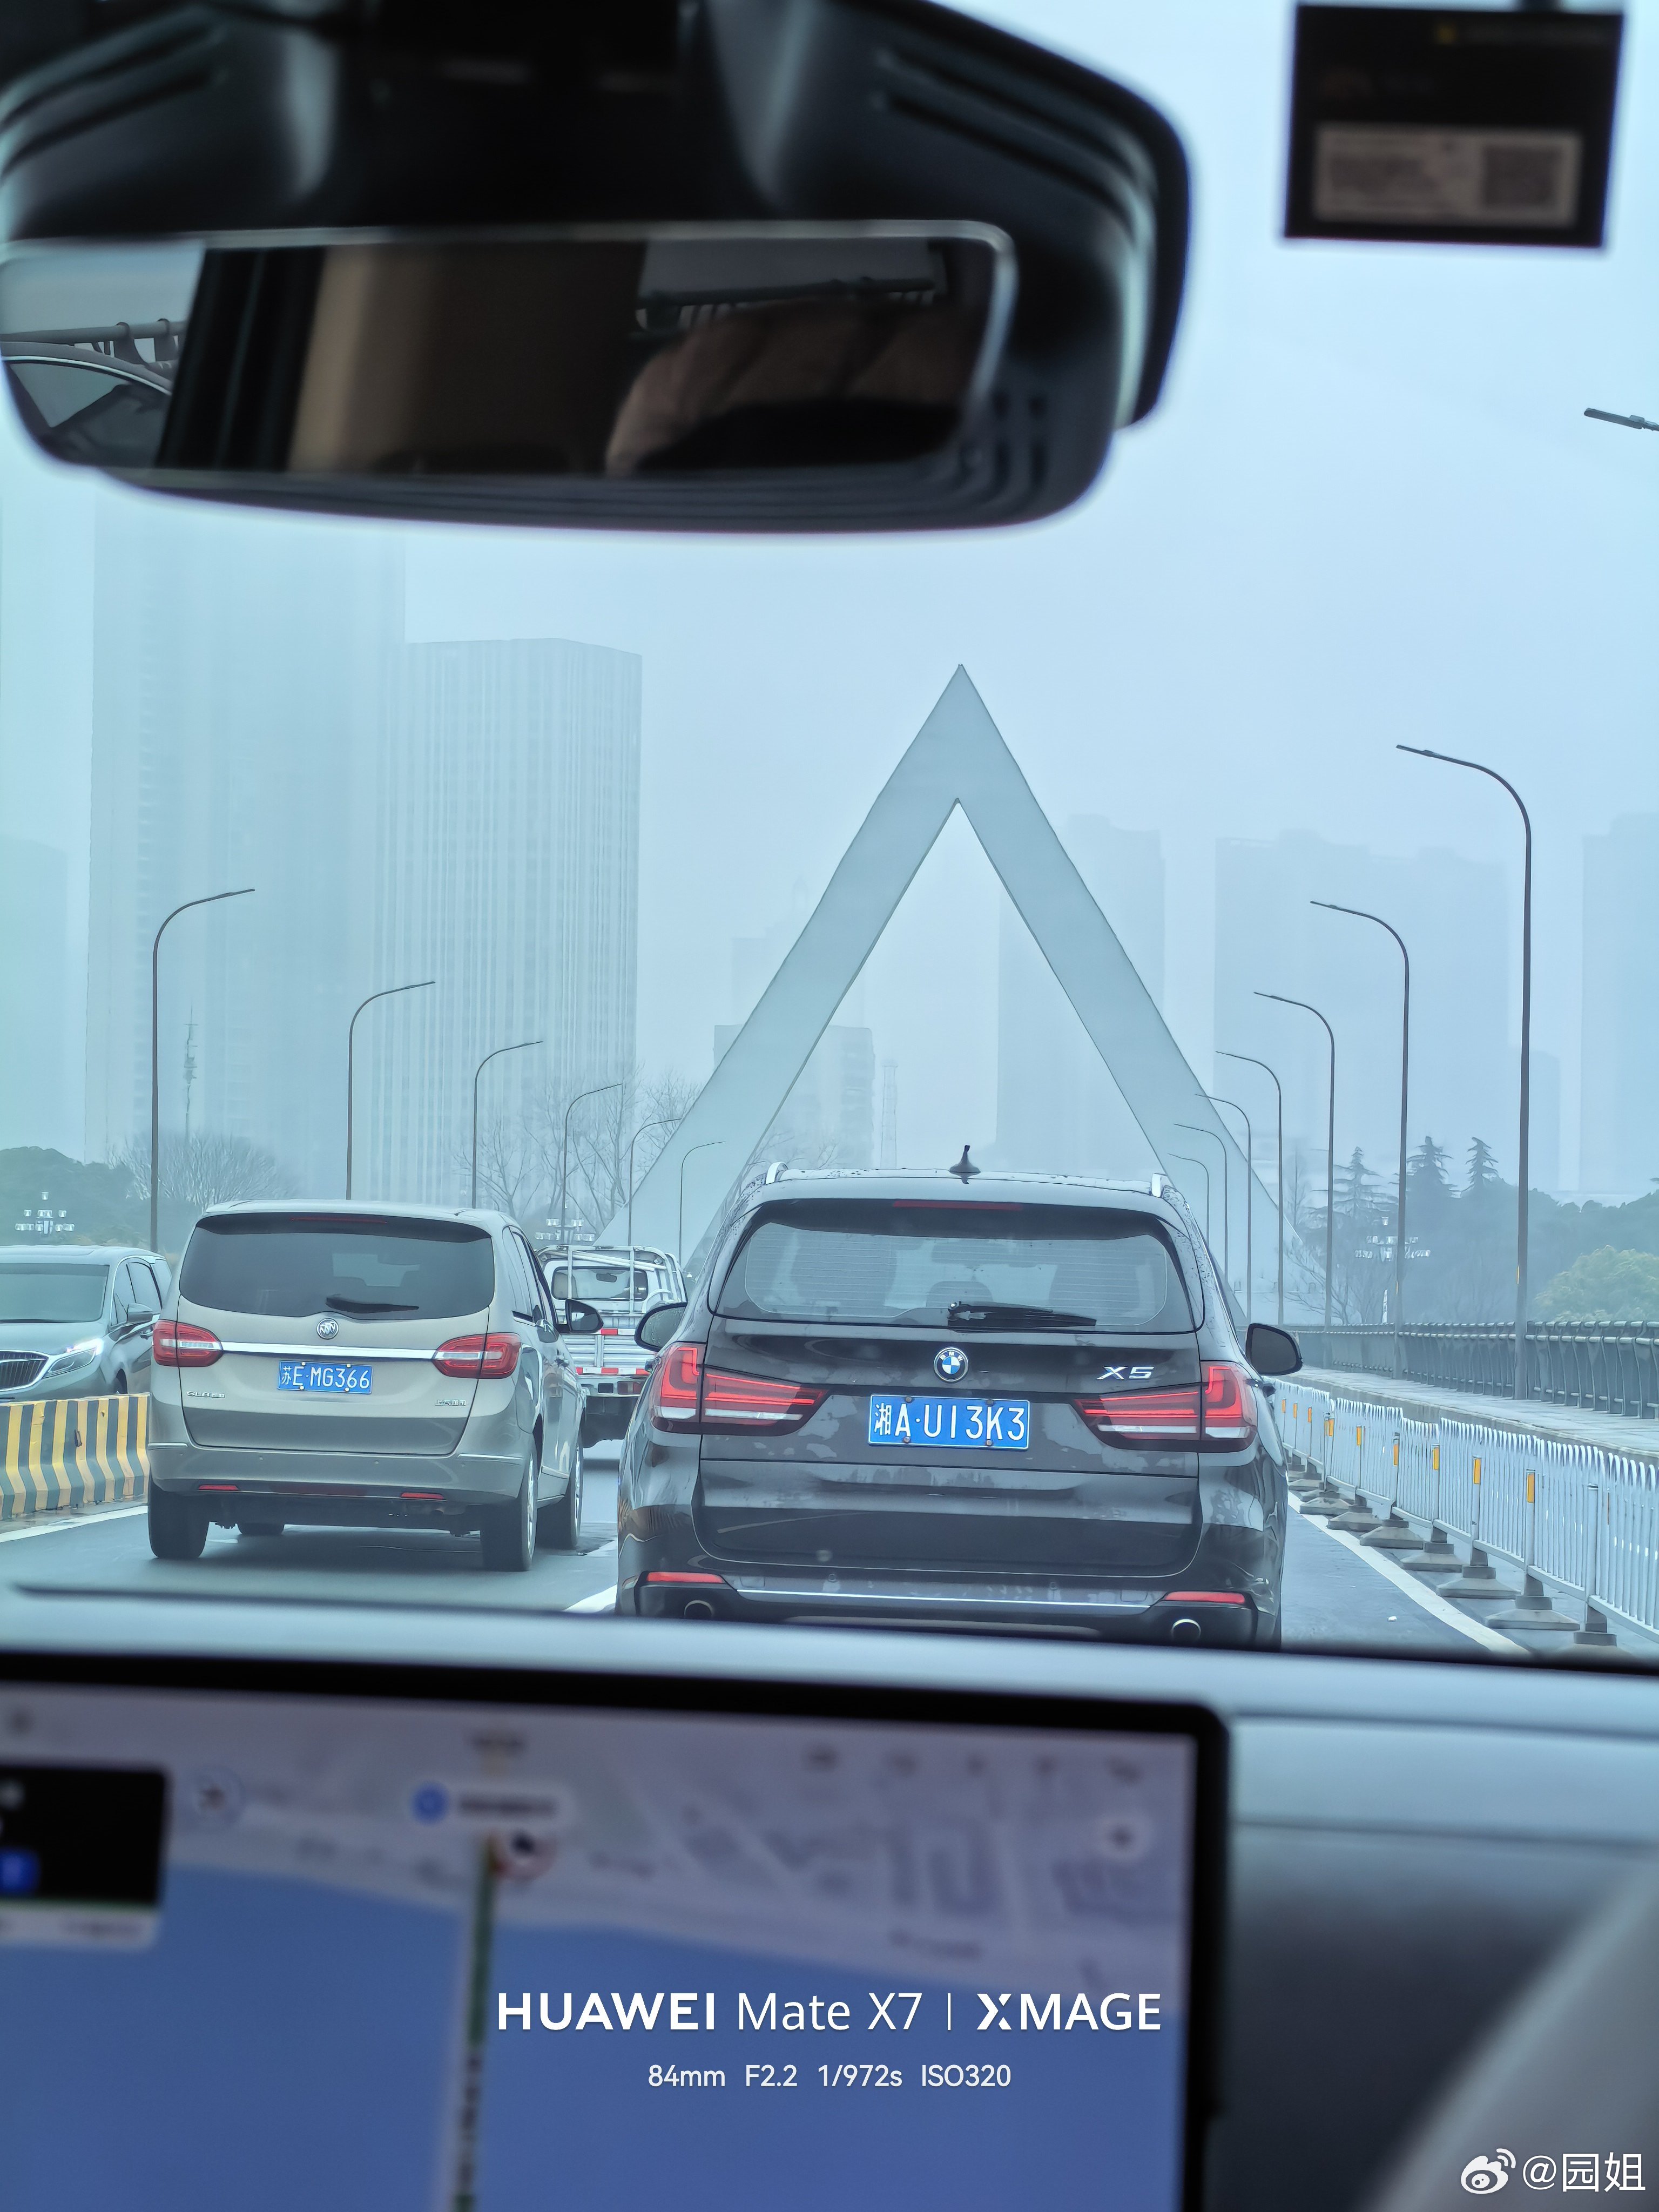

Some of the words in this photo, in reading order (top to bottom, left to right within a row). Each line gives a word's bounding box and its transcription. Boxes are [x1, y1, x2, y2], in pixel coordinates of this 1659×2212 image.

[940, 1351, 963, 1361] BMW
[281, 1365, 370, 1389] 苏E·MG366
[1096, 1366, 1155, 1380] X5
[874, 1402, 1025, 1440] 湘A·U13K3
